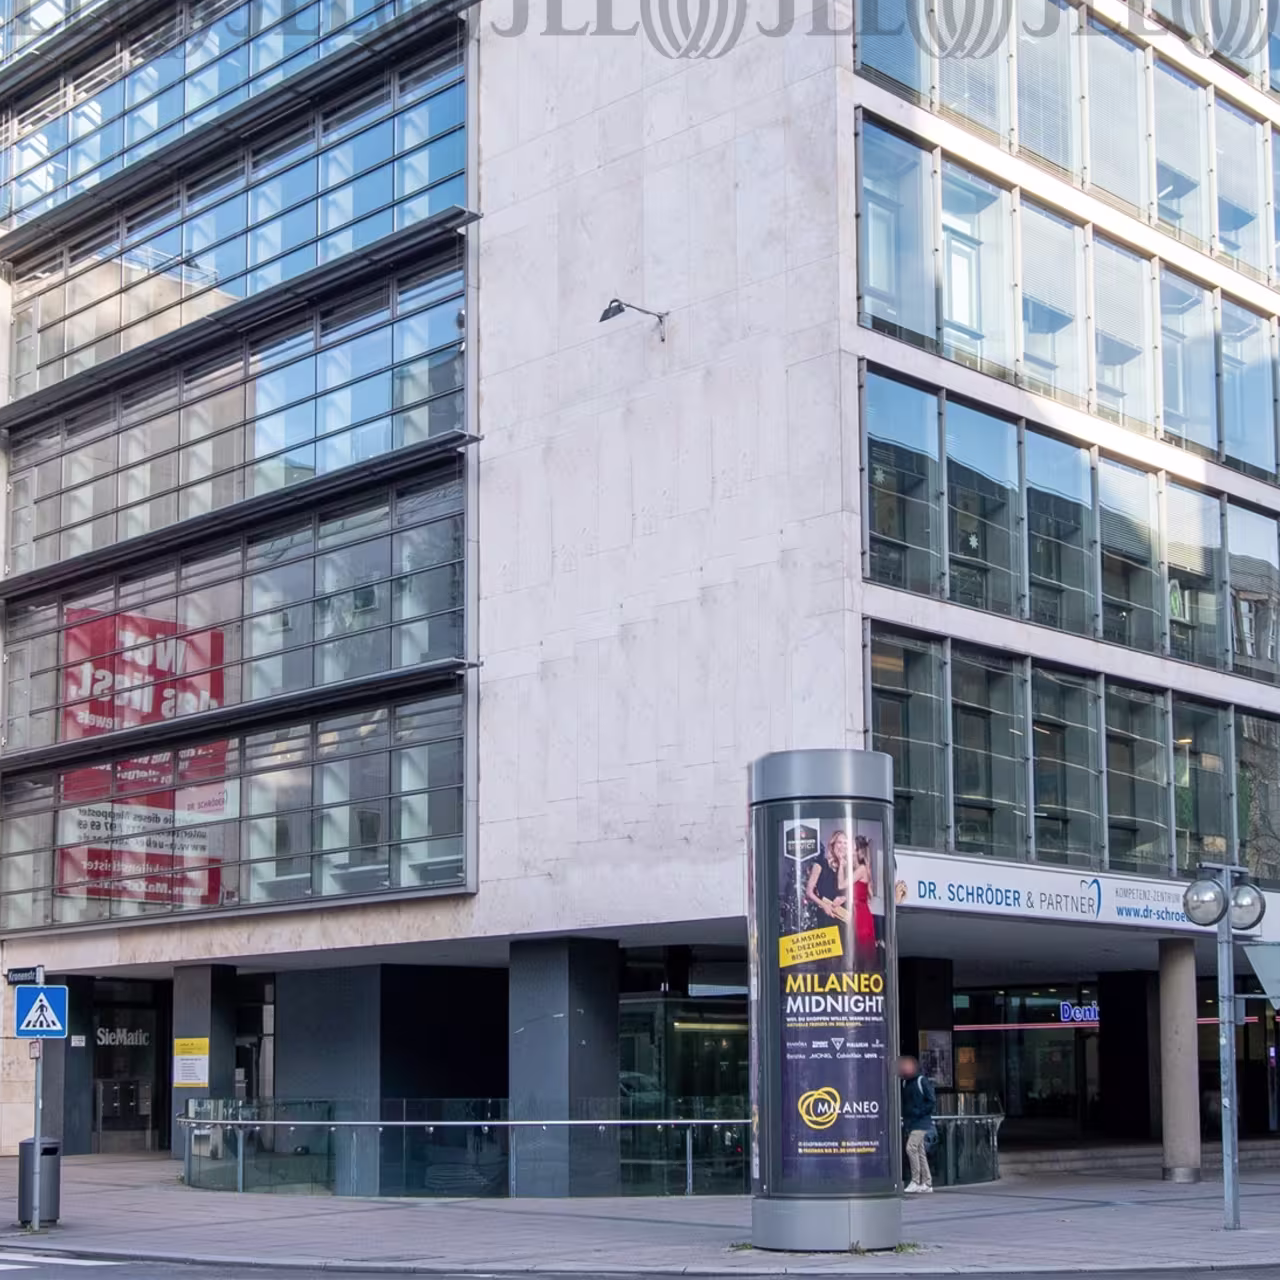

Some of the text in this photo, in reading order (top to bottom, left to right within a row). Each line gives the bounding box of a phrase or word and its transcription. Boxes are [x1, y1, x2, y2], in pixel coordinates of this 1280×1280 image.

[918, 880, 1095, 914] DR. SCHRÖDER & PARTNER
[792, 932, 827, 945] SAMSTAG
[798, 938, 836, 952] DEZEMBER
[815, 948, 832, 956] UHR
[785, 973, 883, 993] MILANEO
[786, 994, 884, 1013] MIDNIGHT
[1061, 1001, 1099, 1021] Deni
[97, 1027, 150, 1046] SieMatic
[817, 1101, 879, 1114] MILANEO
